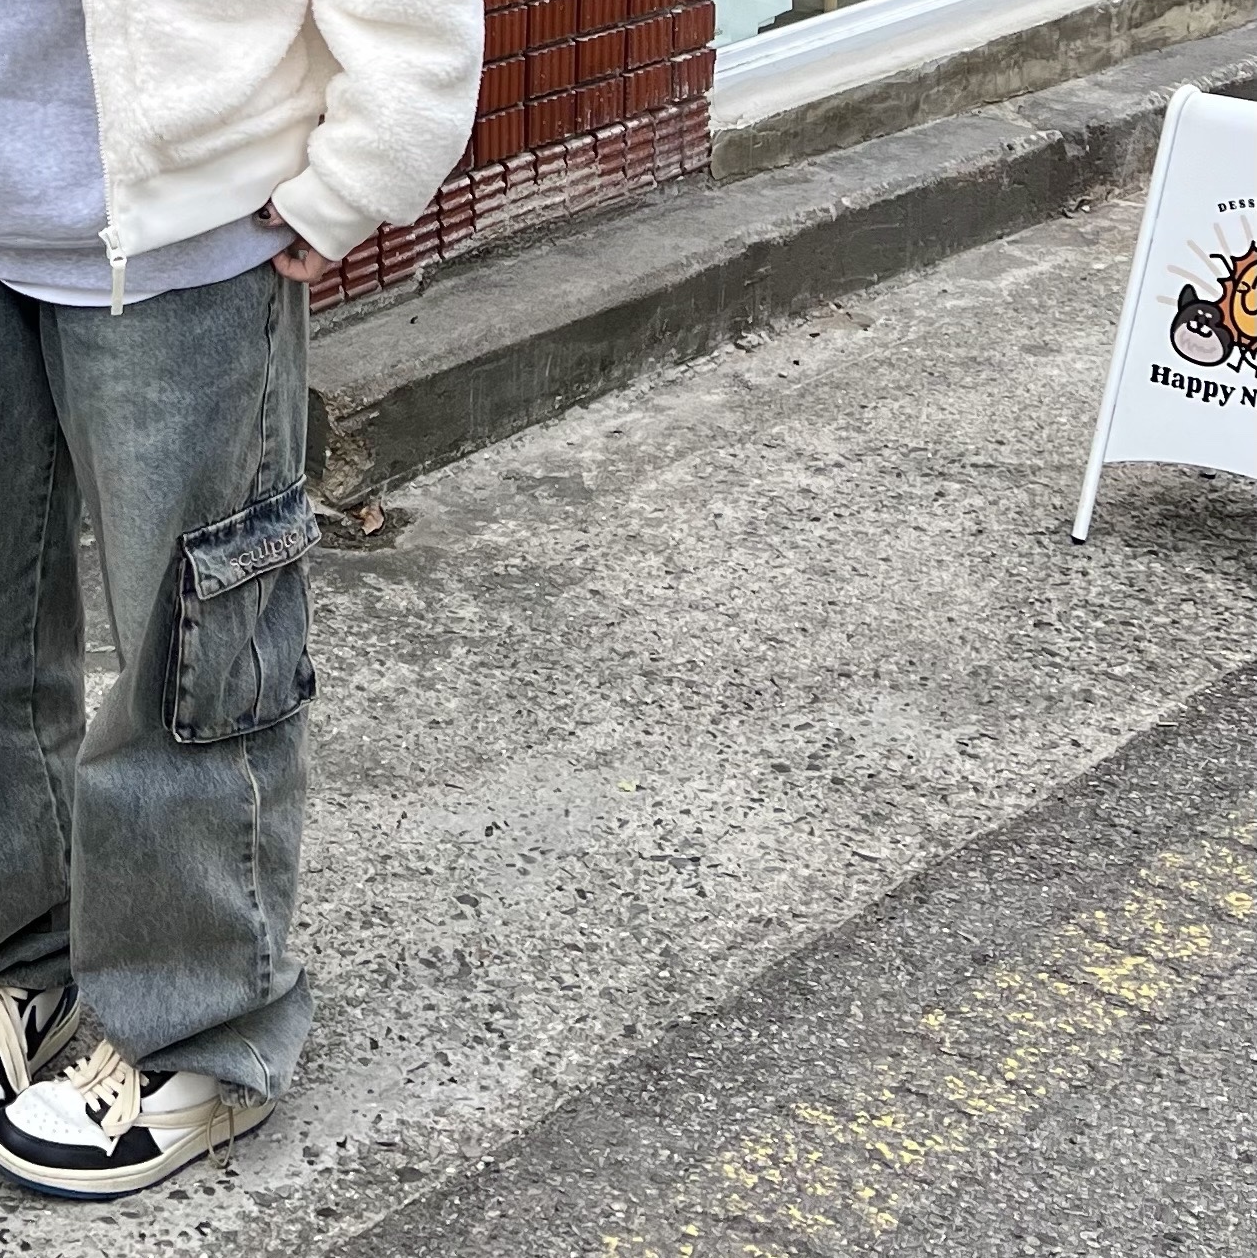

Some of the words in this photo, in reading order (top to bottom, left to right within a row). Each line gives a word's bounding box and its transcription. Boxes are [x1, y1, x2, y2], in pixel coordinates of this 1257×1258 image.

[1217, 199, 1256, 213] DESS
[1150, 364, 1236, 407] Happy
[230, 530, 305, 571] sculpto
